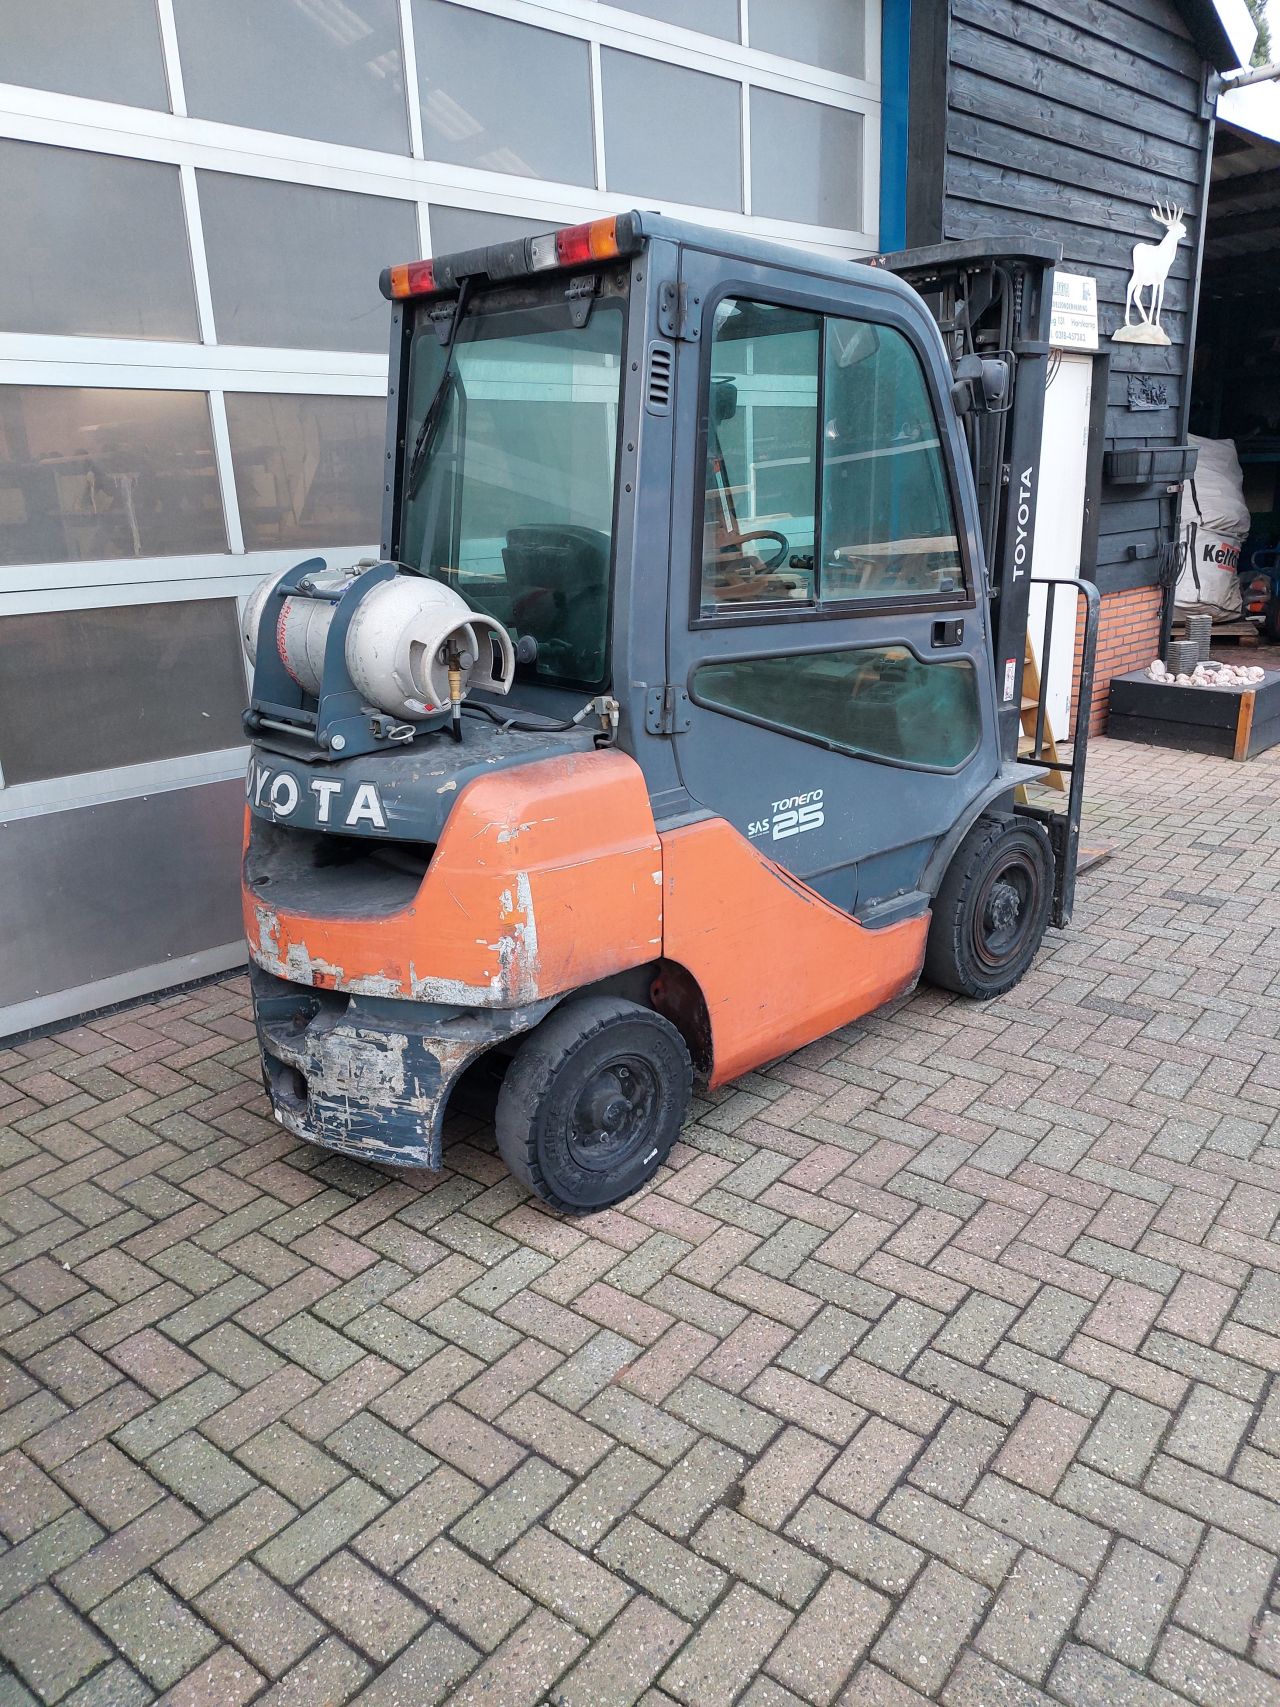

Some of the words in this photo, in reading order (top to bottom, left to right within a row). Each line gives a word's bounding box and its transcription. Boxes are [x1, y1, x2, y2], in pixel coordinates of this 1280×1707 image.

[1012, 466, 1033, 582] TOYOTA
[246, 757, 386, 828] OYOTA
[747, 818, 770, 836] SAS
[772, 801, 825, 841] 25
